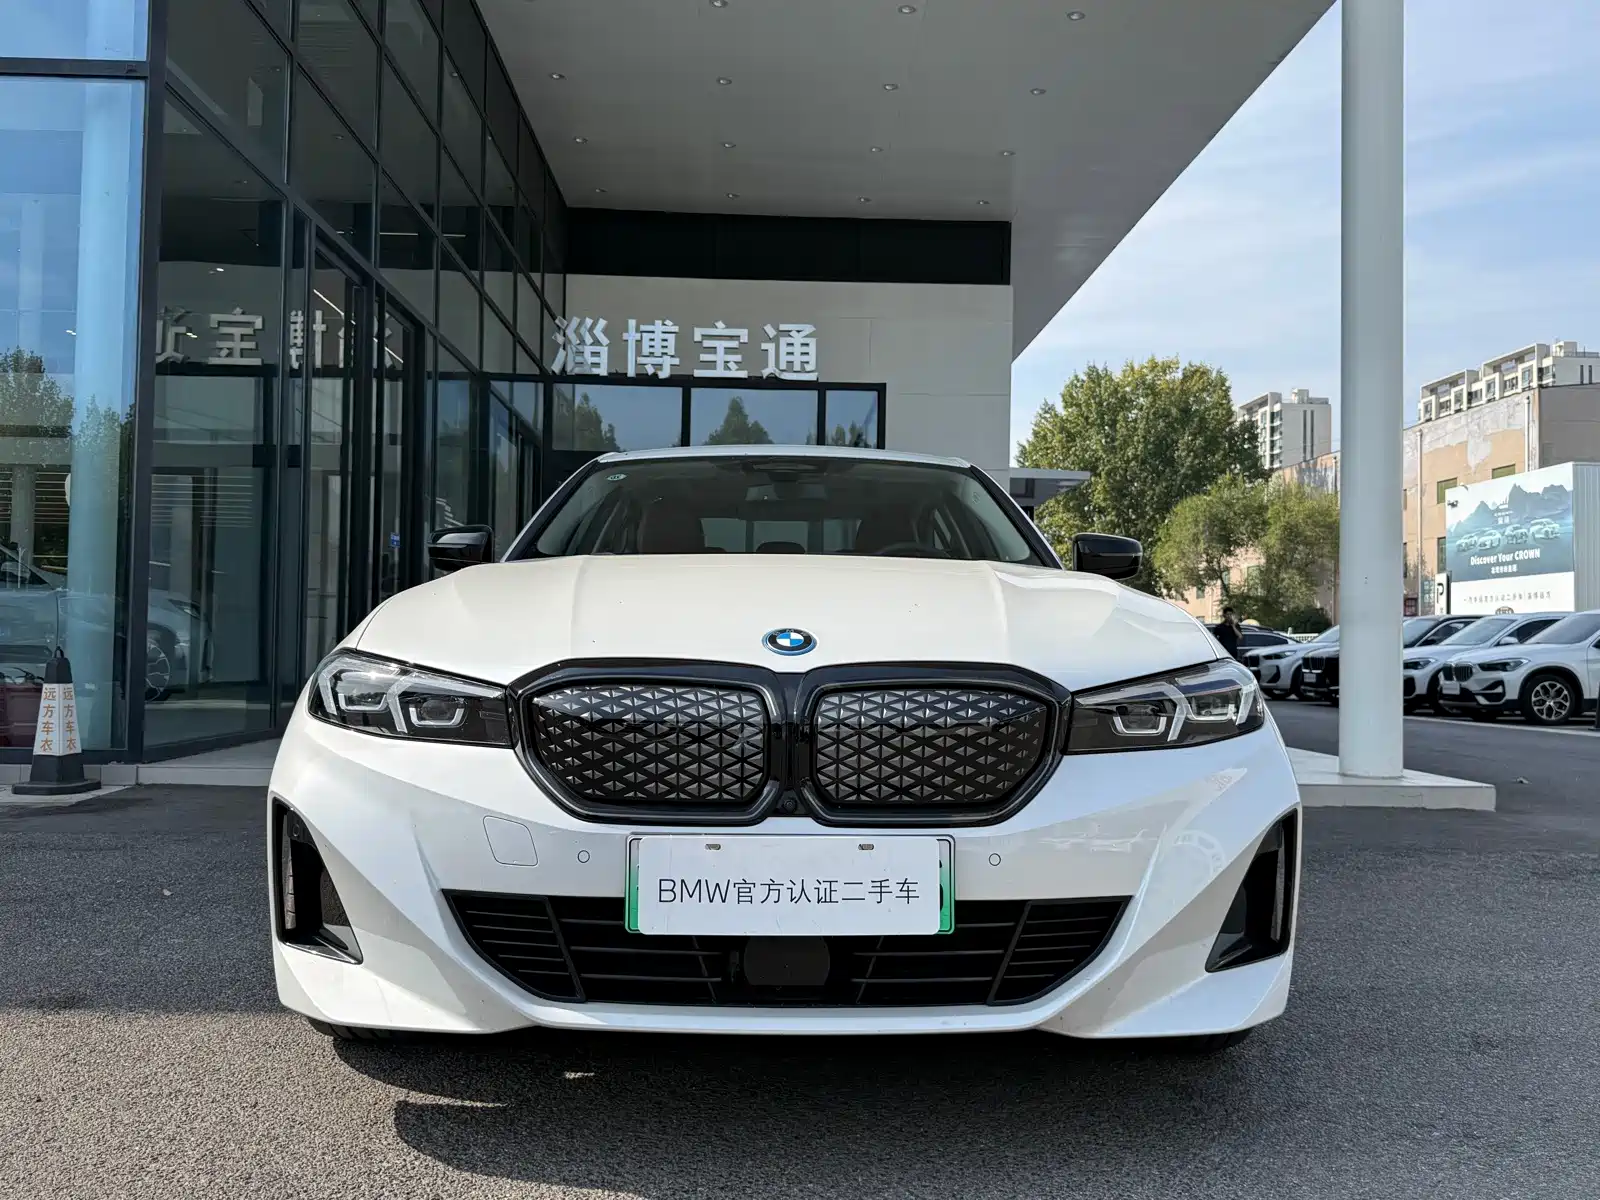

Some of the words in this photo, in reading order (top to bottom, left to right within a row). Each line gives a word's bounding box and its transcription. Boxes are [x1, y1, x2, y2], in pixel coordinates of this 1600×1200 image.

[551, 316, 819, 380] 淄博宝通
[1470, 555, 1498, 566] Discover
[1498, 553, 1513, 563] Your
[1514, 548, 1541, 560] CROWN
[40, 687, 57, 752] 远方车衣
[63, 687, 77, 752] 远方车衣
[658, 877, 921, 905] BMW官方认证二手车
